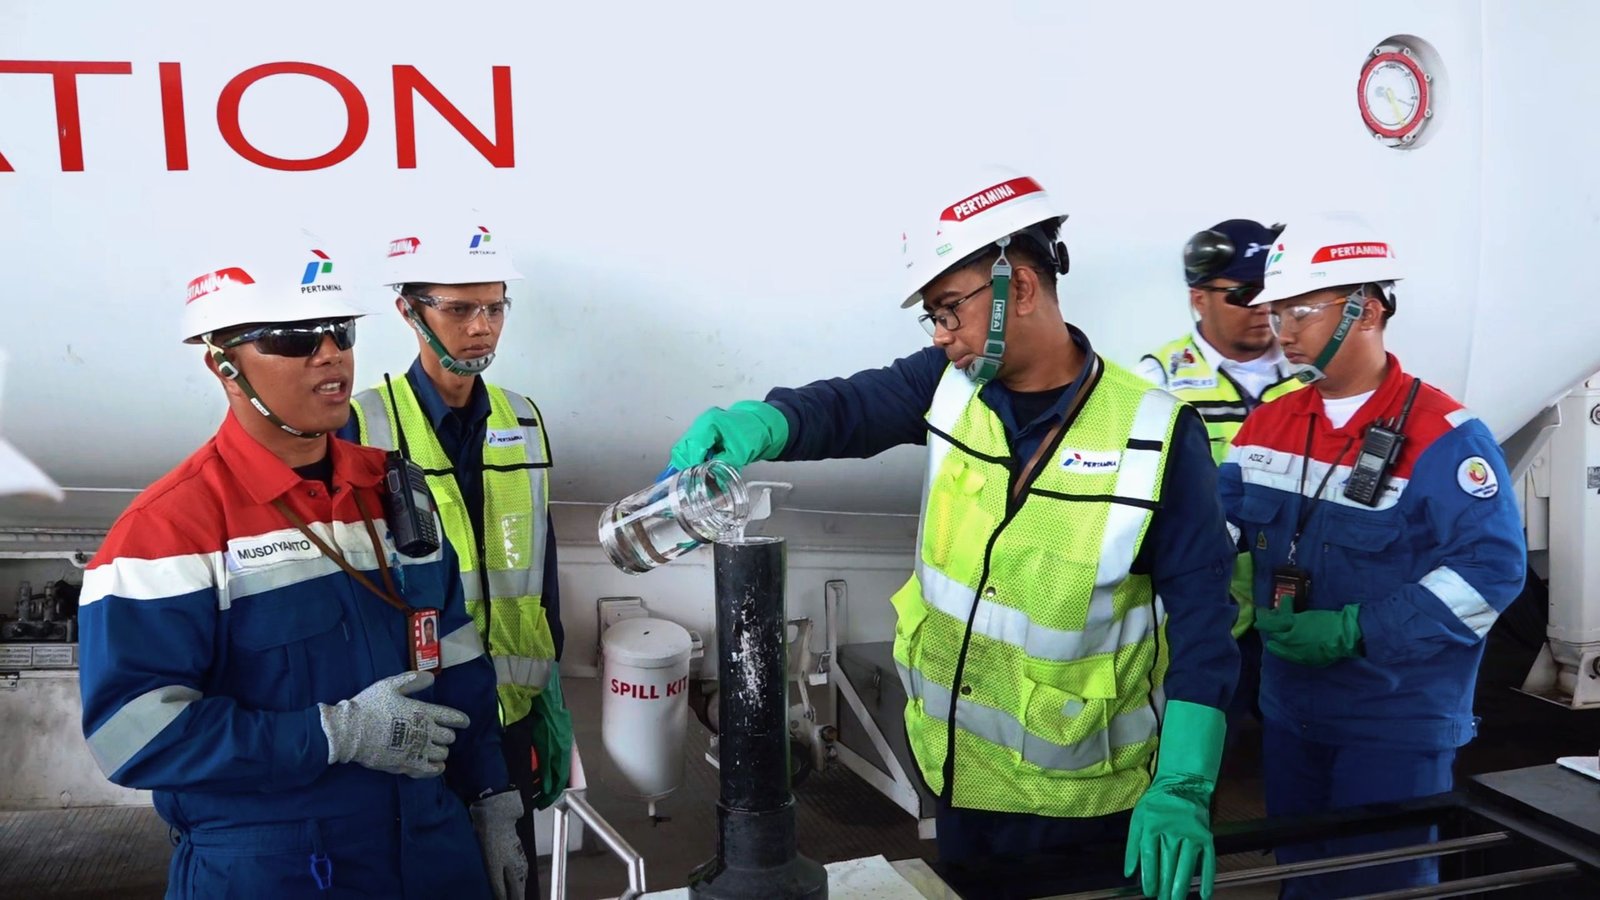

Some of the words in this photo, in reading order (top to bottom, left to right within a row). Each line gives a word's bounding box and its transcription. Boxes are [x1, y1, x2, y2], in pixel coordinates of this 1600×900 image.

[0, 59, 515, 171] TION
[953, 184, 1016, 220] PERTAMINA
[1330, 246, 1387, 259] PERTAMINA
[301, 284, 342, 294] PERTAMINA
[993, 303, 1003, 328] MSA
[1265, 457, 1273, 465] J
[237, 540, 311, 560] MUSDIYANTO
[611, 678, 660, 699] SPILL
[666, 675, 688, 697] KIT
